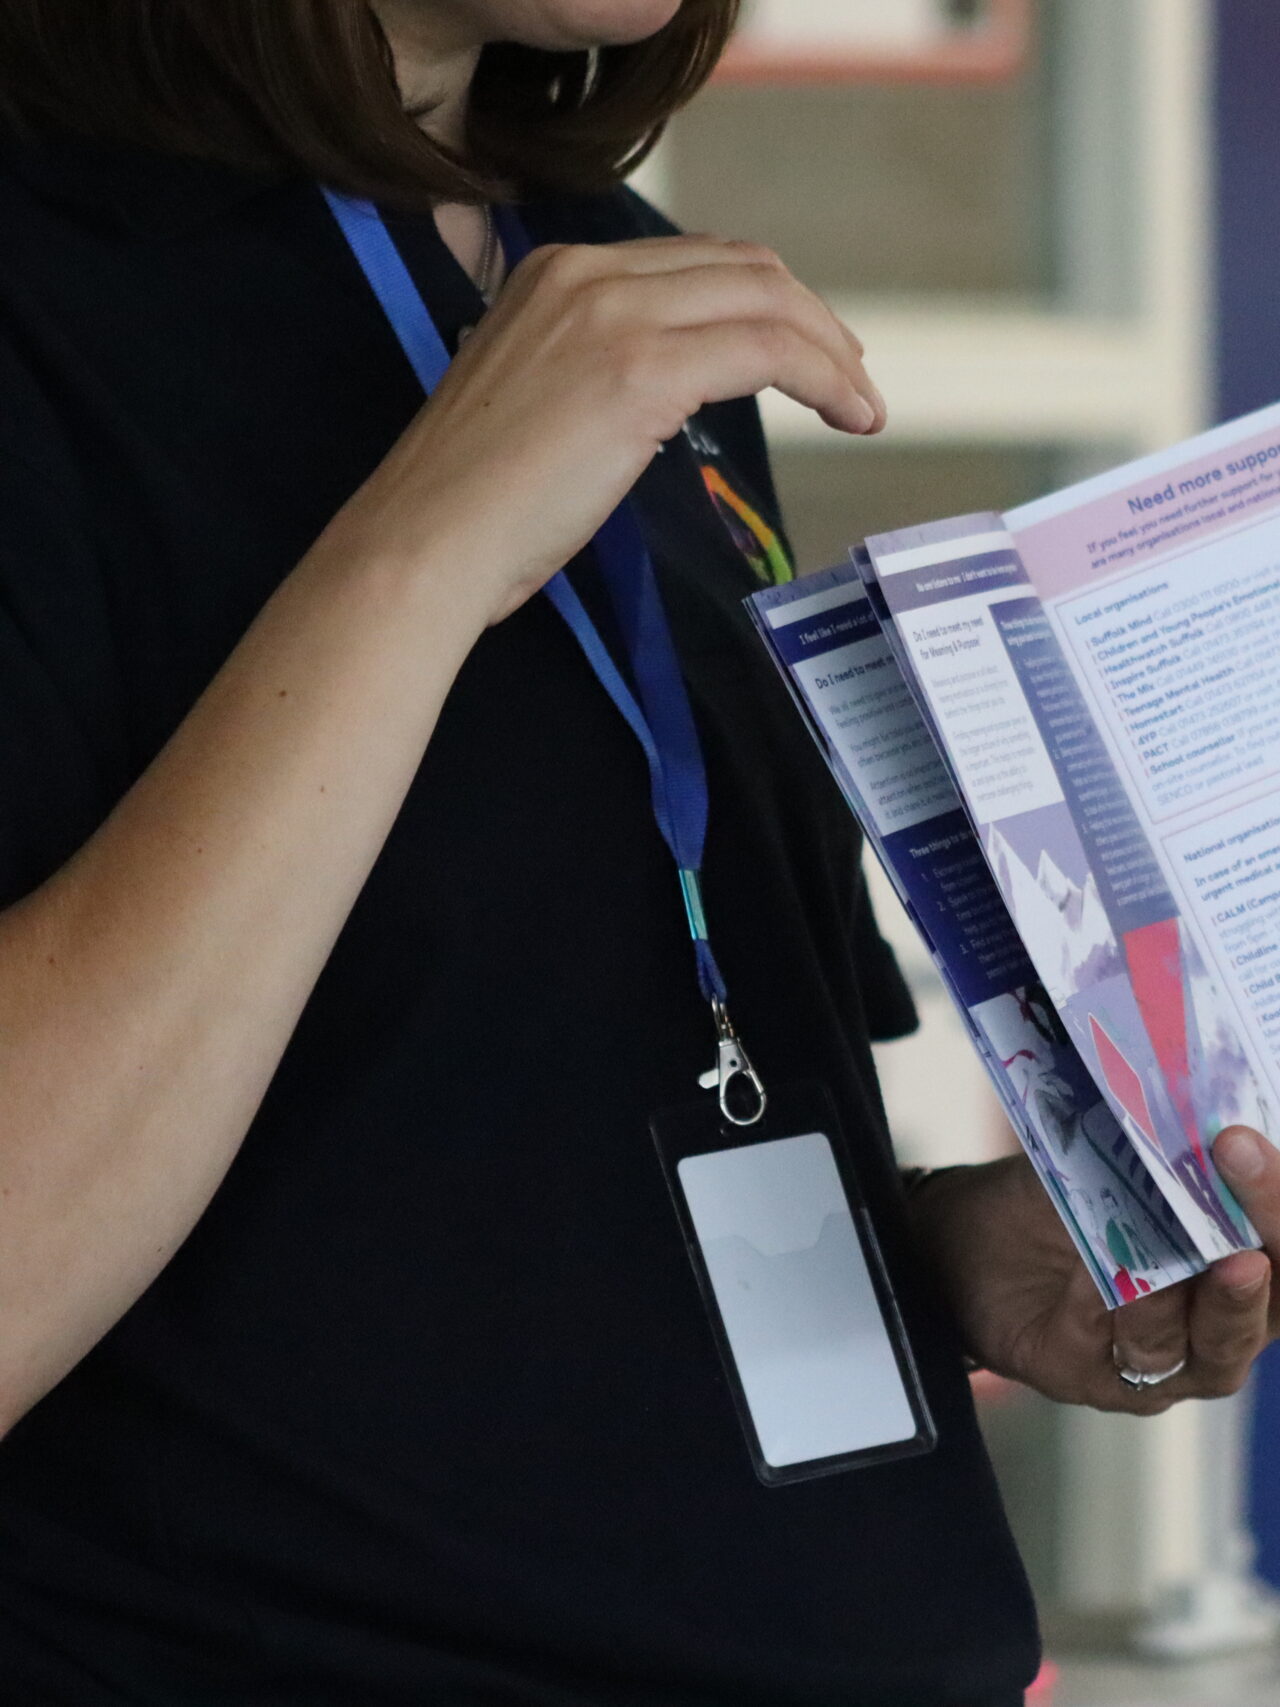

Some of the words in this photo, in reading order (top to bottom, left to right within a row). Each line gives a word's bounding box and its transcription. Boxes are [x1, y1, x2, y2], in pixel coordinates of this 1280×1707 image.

[1129, 485, 1175, 514] Need
[1179, 468, 1223, 495] more
[1099, 537, 1117, 552] you
[1118, 526, 1137, 541] feel
[1140, 520, 1157, 535] you
[1160, 508, 1182, 525] need
[1184, 495, 1218, 514] further
[1221, 477, 1257, 499] support
[1259, 473, 1273, 483] for
[1092, 558, 1107, 569] are
[1108, 547, 1135, 562] many
[1137, 520, 1201, 551] organisations
[1201, 508, 1225, 524] local
[1228, 500, 1245, 513] and
[1075, 608, 1102, 625] Local
[1105, 583, 1169, 613] organisations
[927, 627, 940, 639] need
[949, 621, 962, 633] meet
[1092, 626, 1126, 646] Suffolk
[1129, 615, 1152, 631] Mind
[1153, 607, 1172, 621] Call
[1098, 640, 1138, 660] Children
[1141, 630, 1158, 643] and
[1161, 619, 1190, 634] Young
[1191, 601, 1232, 622] People's
[1233, 579, 1280, 605] Emotional
[929, 644, 954, 658] Meaning
[1104, 642, 1167, 674] Healthwatch
[1169, 628, 1203, 648] Suffolk
[1206, 619, 1225, 632] Call
[835, 668, 855, 683] need
[865, 658, 887, 673] meet
[1111, 671, 1145, 689] Inspire
[1147, 654, 1181, 674] Suffolk
[1183, 645, 1201, 659] Call
[1118, 691, 1135, 703] The
[1138, 684, 1154, 695] Mix
[1125, 696, 1163, 716] Teenage
[1166, 680, 1199, 700] Mental
[1201, 665, 1234, 685] Health
[1130, 703, 1183, 731] Homestart
[1137, 731, 1158, 745] 4YP
[1144, 743, 1170, 760] PACT
[1151, 754, 1183, 774] School
[1186, 734, 1236, 759] counsellor
[1185, 840, 1225, 863] National
[1202, 881, 1233, 901] urgent
[1236, 865, 1273, 886] medical
[1208, 868, 1229, 881] case
[1217, 904, 1246, 922] CALM
[1237, 944, 1278, 965] Childline
[1250, 977, 1274, 993] Child
